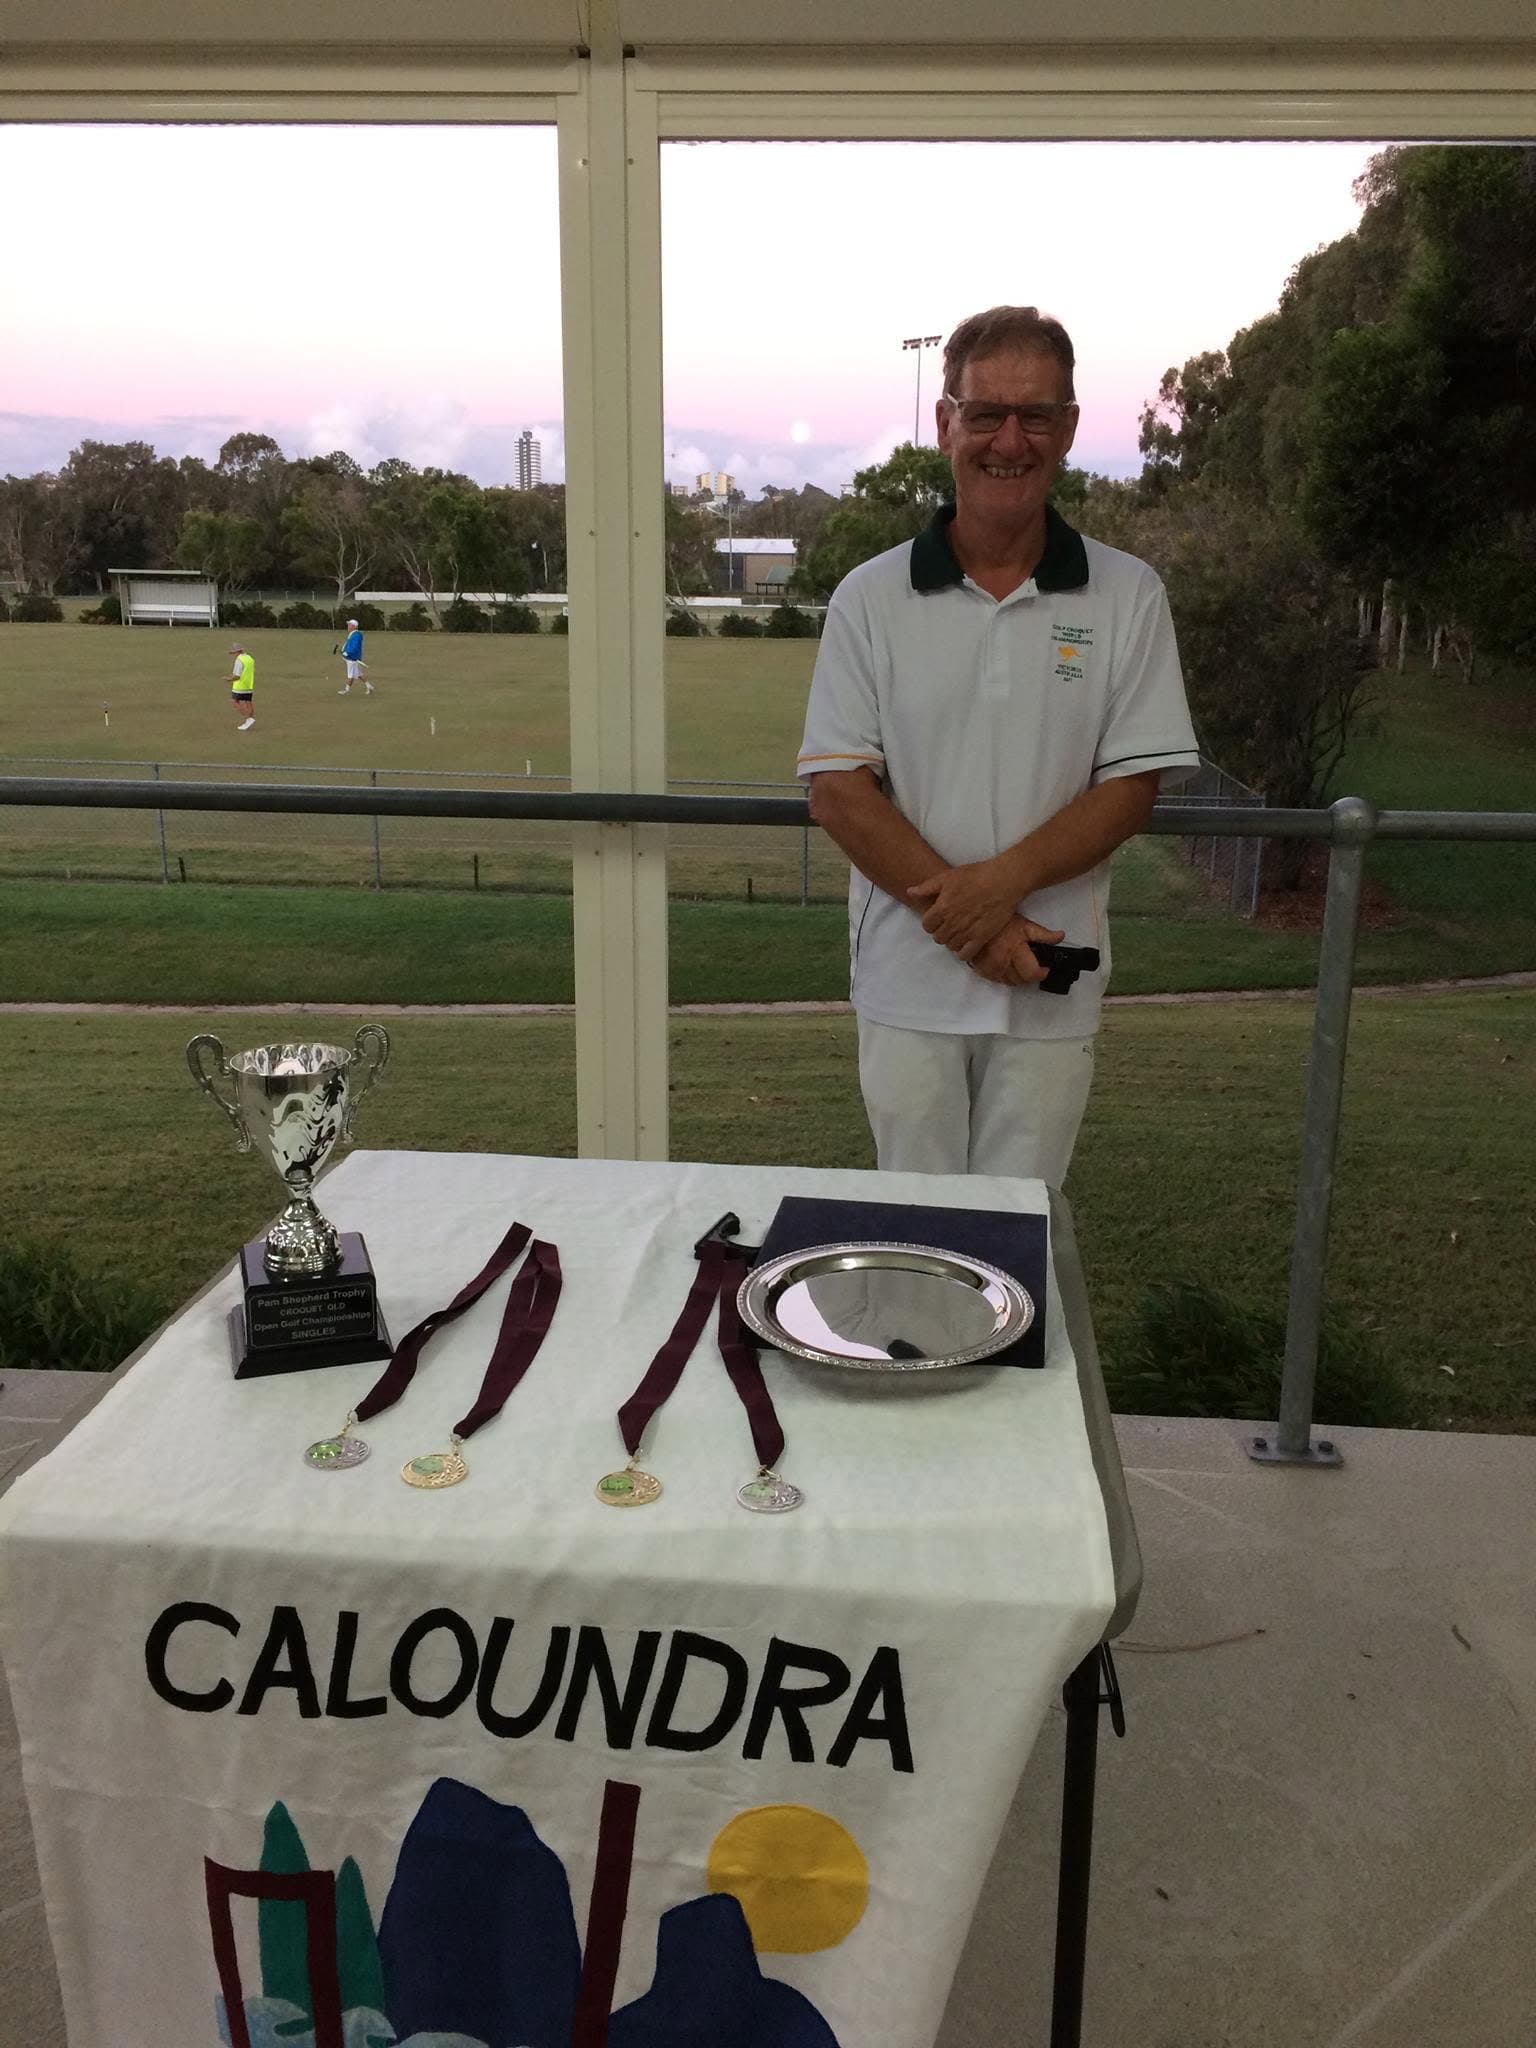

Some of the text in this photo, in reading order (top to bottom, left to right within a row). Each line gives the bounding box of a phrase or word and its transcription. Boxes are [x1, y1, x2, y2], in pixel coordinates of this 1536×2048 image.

[257, 1298, 280, 1308] Pam
[333, 1289, 366, 1300] Trophy
[280, 1304, 323, 1317] CROQUET
[254, 1310, 372, 1332] Open Golf Championships
[291, 1326, 337, 1340] SINGLES
[145, 1601, 915, 1773] CALOUNDRA
